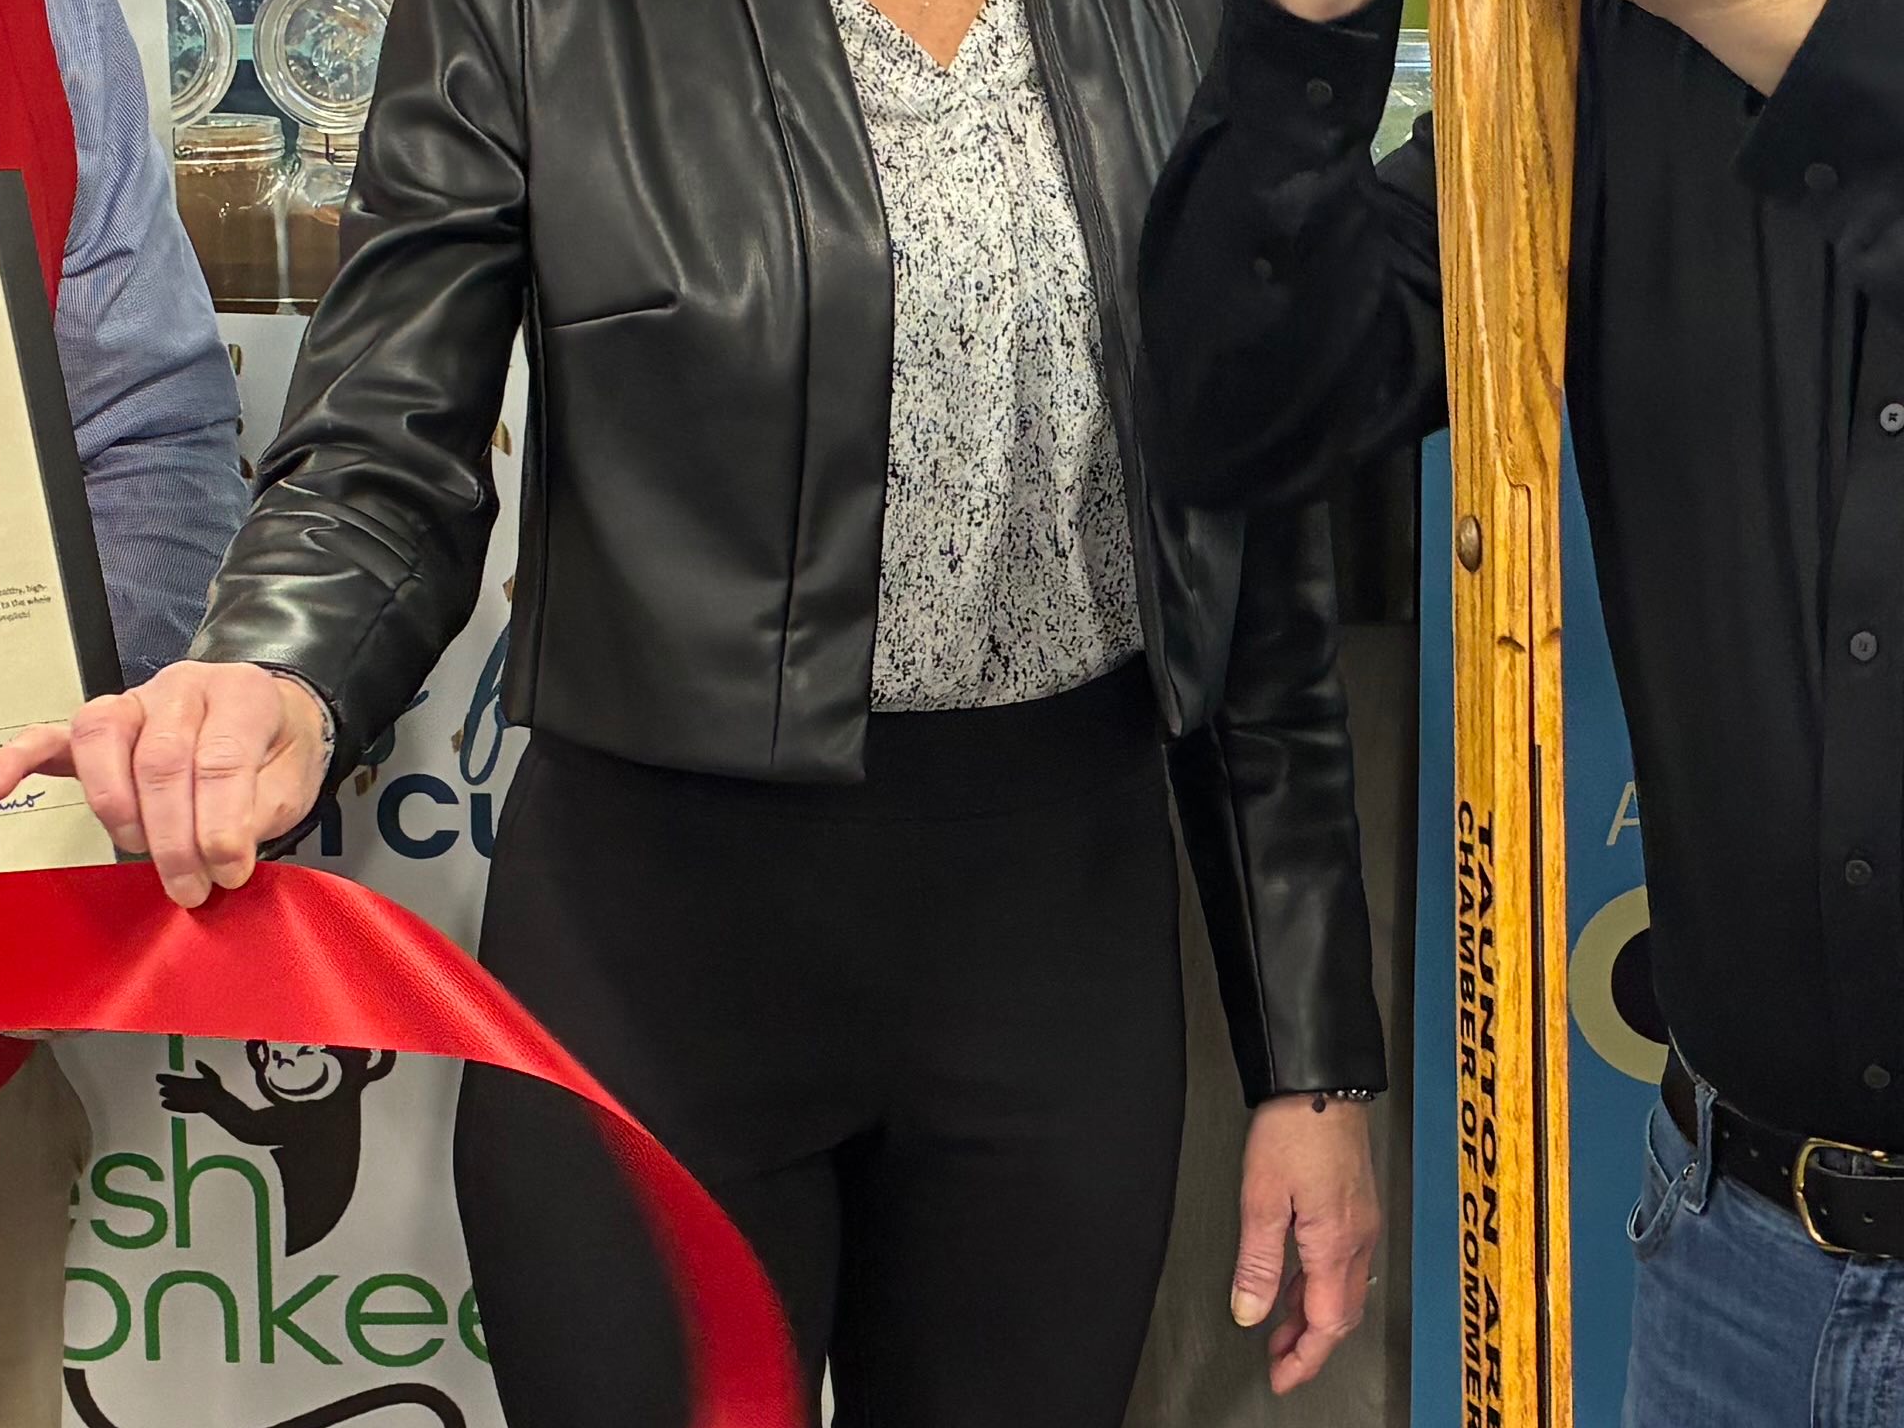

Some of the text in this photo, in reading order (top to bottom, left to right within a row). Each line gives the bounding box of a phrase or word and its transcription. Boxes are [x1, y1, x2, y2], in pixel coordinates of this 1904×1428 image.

[1458, 802, 1476, 1079] CHAMBER
[1478, 812, 1499, 1246] TAUNTON
[1460, 1102, 1476, 1173] OF
